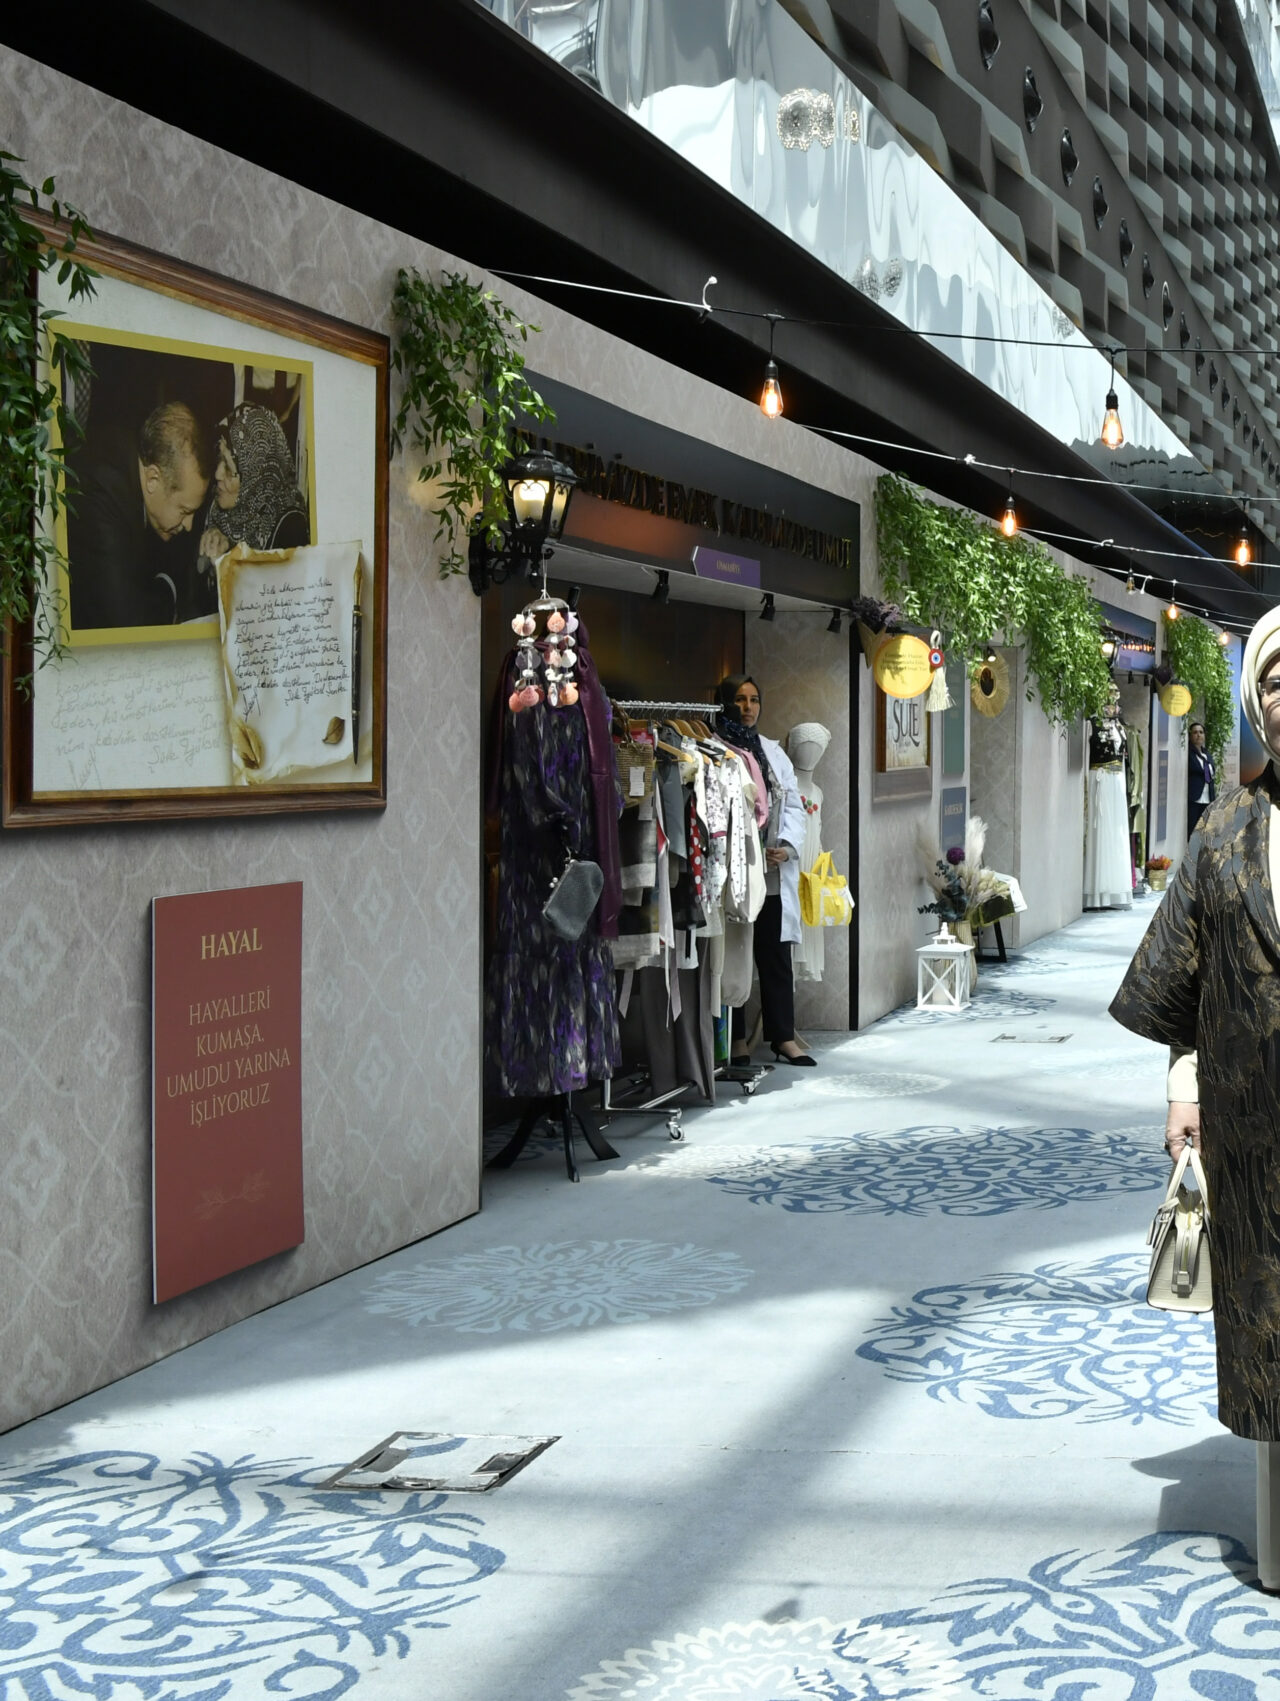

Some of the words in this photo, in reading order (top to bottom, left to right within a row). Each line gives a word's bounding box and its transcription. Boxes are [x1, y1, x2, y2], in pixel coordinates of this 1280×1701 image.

[816, 528, 854, 569] UMUT
[200, 927, 263, 961] HAYAL
[188, 985, 272, 1027] HAYALLERİ
[195, 1023, 265, 1058] KUMAŞA,
[166, 1061, 231, 1098] UMUDU
[234, 1047, 292, 1080] YARINA
[190, 1082, 271, 1128] İŞLİYORUZ
